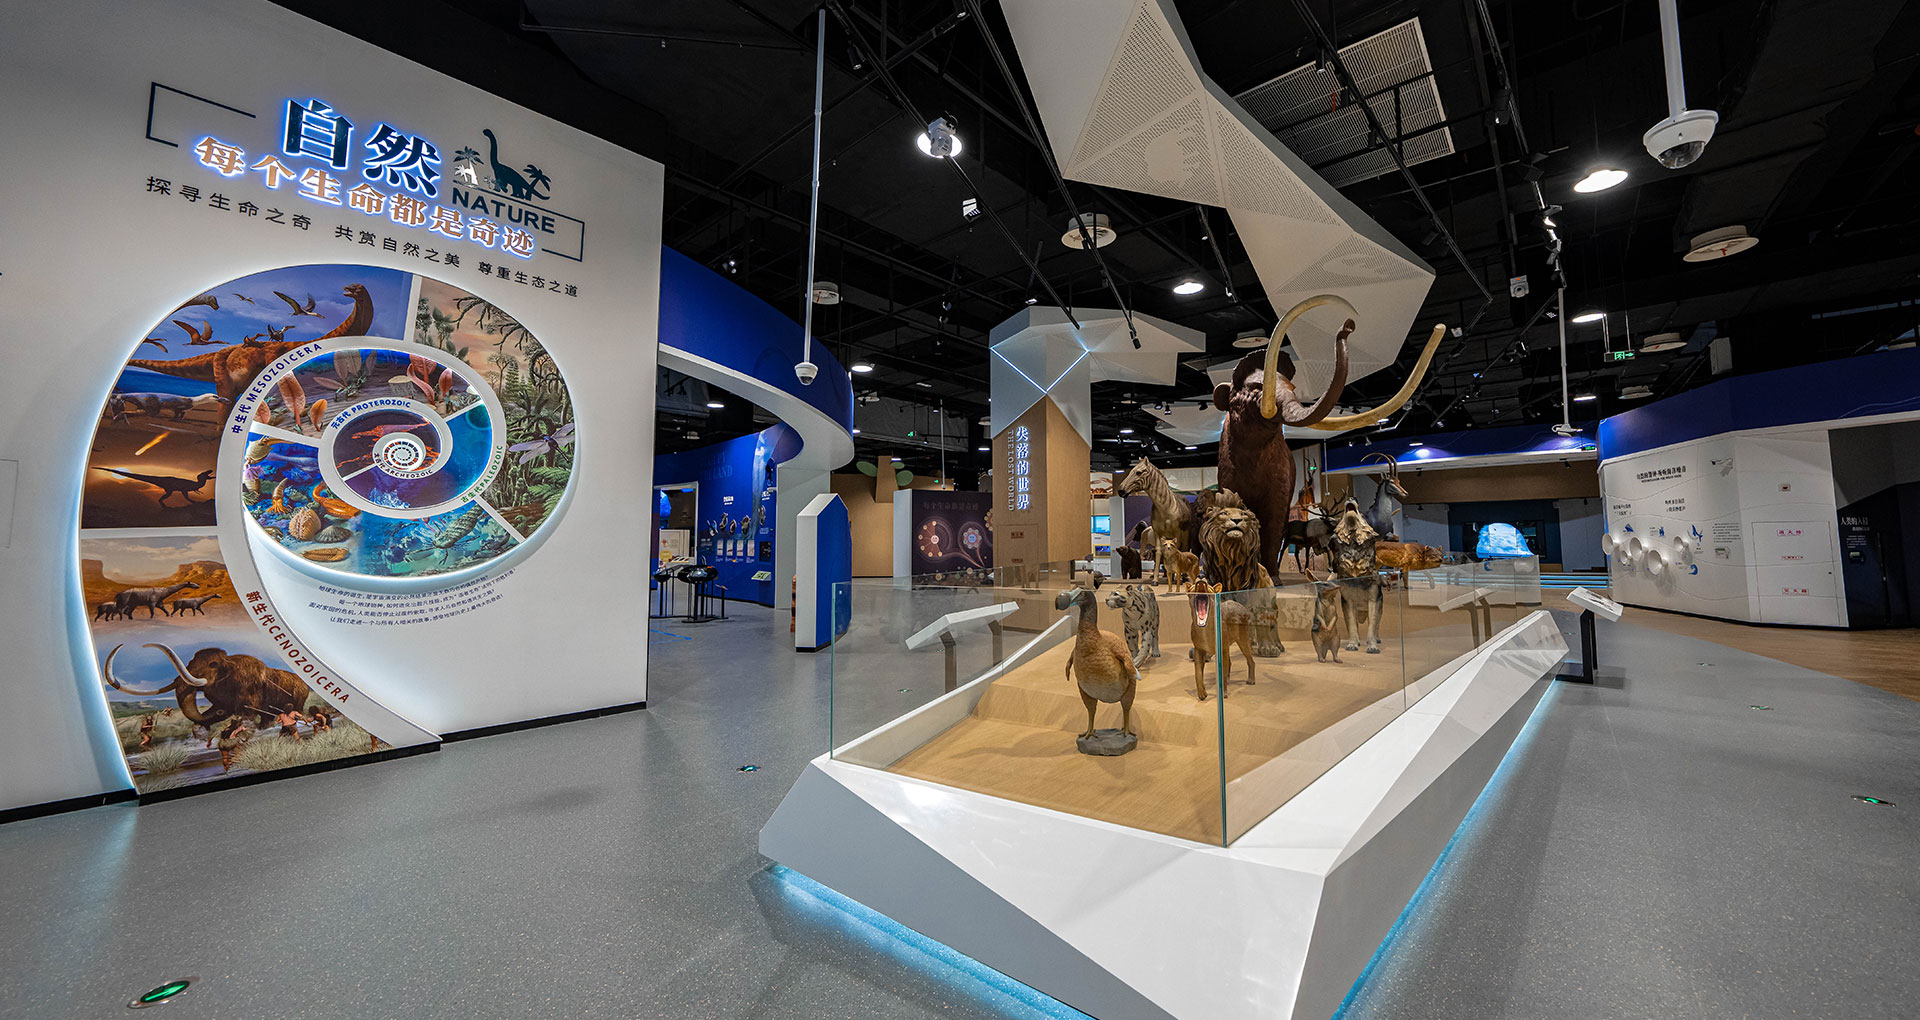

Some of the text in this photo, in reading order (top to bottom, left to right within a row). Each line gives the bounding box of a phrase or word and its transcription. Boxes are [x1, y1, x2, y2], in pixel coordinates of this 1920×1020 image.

[283, 98, 441, 197] 自然
[194, 135, 535, 258] 每个生命都是奇迹
[451, 188, 556, 235] NATURE
[145, 175, 579, 298] 探寻生命之奇 共赏自然之美 尊重生态之道
[231, 403, 252, 434] 中生代
[330, 399, 412, 430] 元古代 PROTEROZOIC
[385, 469, 434, 479] ARCHEOZOIC
[479, 445, 503, 488] PALEOZOIC
[1007, 450, 1015, 476] LOST
[1016, 425, 1030, 511] 失落的世界
[246, 590, 276, 627] 新生代
